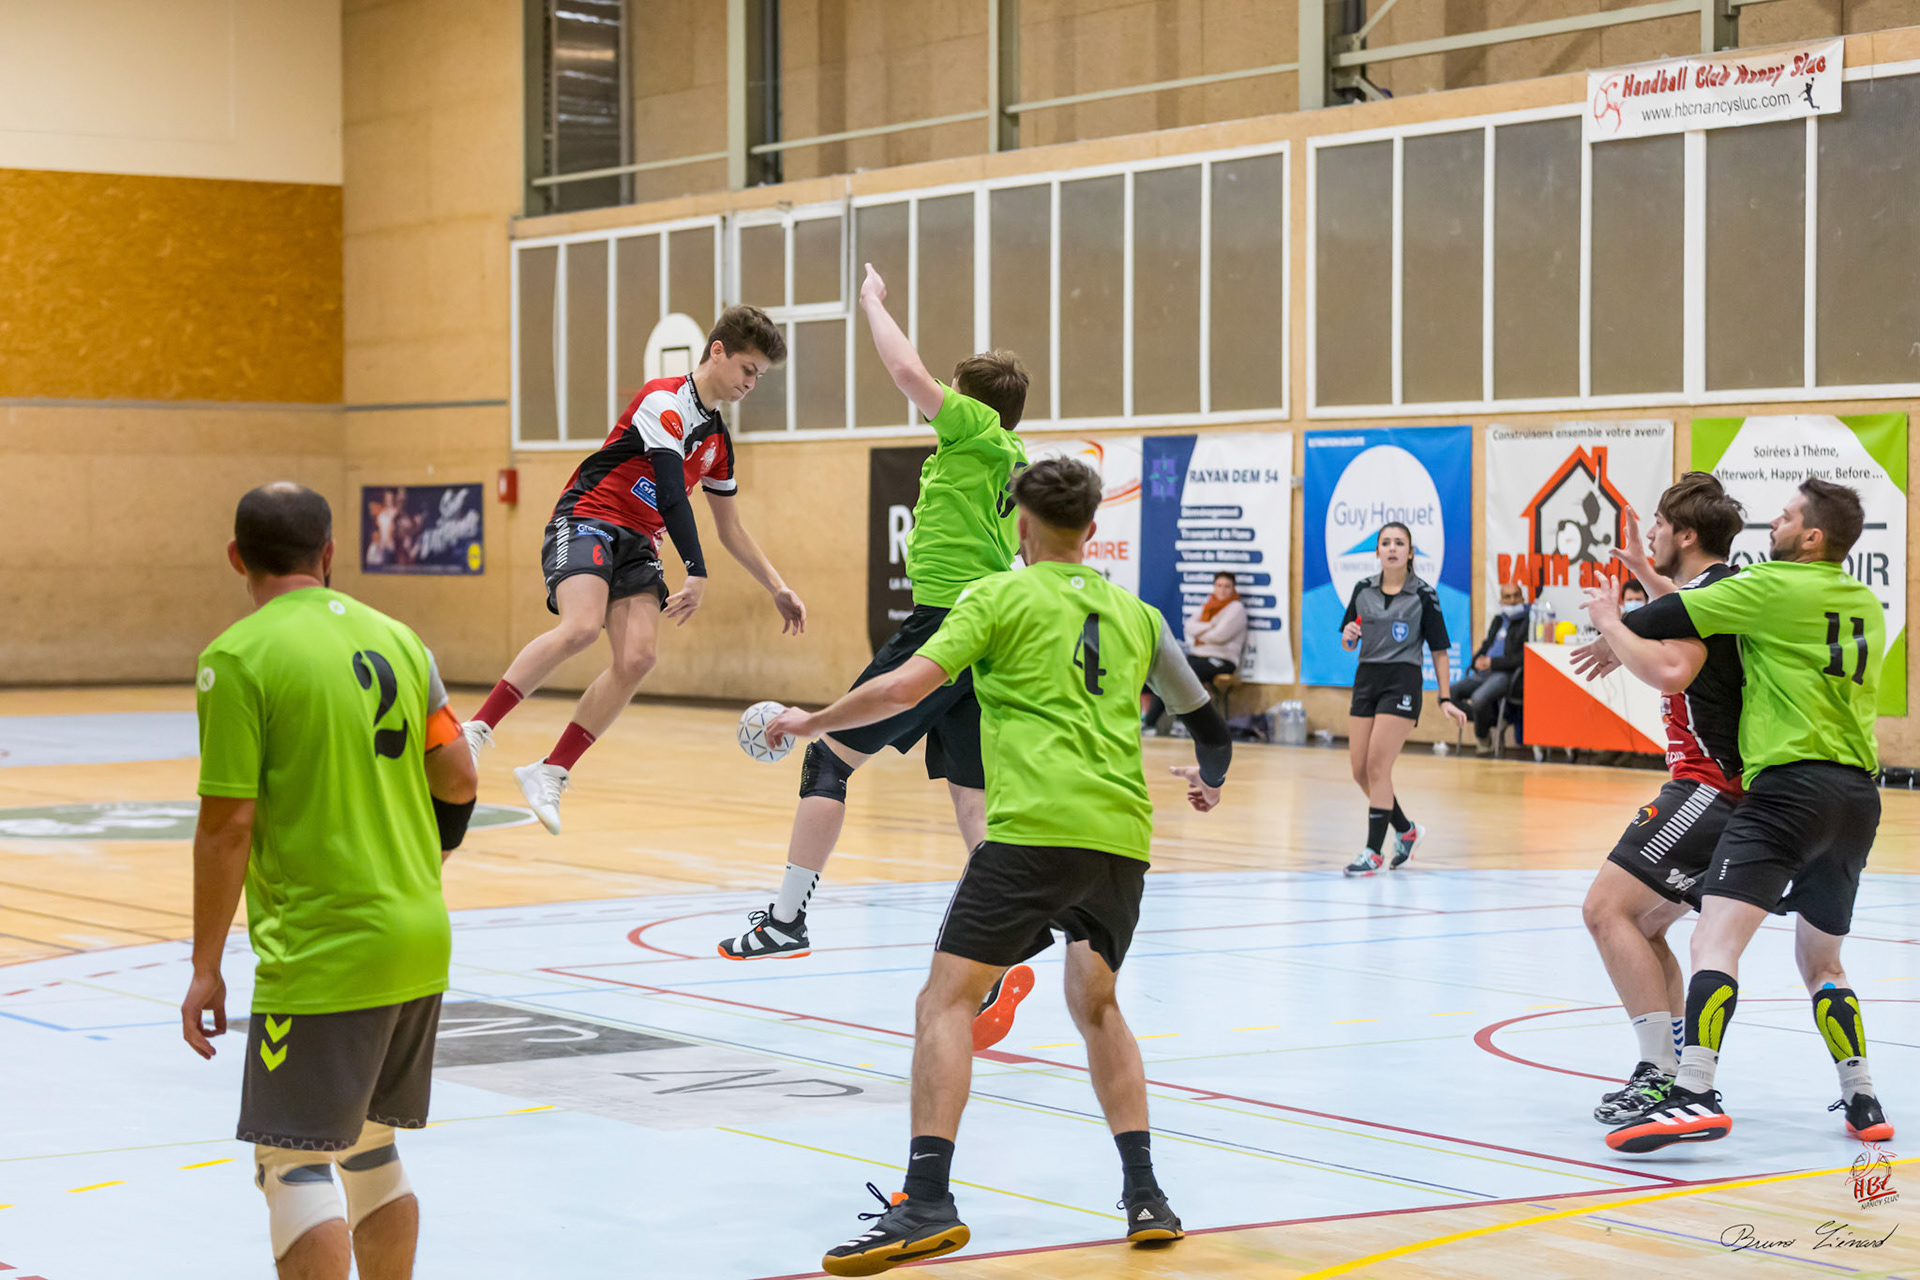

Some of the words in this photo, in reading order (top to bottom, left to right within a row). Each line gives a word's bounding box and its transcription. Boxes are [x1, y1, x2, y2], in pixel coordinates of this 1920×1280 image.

[1622, 66, 1687, 98] Handball
[1695, 64, 1731, 88] Club
[1734, 64, 1785, 87] Nancy
[1790, 52, 1826, 77] Sluc
[1641, 92, 1791, 121] www.hbcnancysluc.com
[1492, 429, 1554, 441] Construisons
[1555, 427, 1602, 439] ensemble
[1605, 427, 1631, 438] votre
[1634, 425, 1666, 437] avenir
[1753, 445, 1791, 458] Soirées
[1793, 445, 1800, 457] à
[1802, 444, 1839, 459] Thème,
[1189, 470, 1229, 483] RAYAN
[1232, 470, 1260, 483] DEM
[1265, 469, 1278, 483] 54
[1771, 468, 1802, 482] Happy
[1806, 467, 1833, 480] Hour,
[1334, 502, 1367, 531] Guy
[1073, 612, 1106, 696] 4
[1823, 612, 1868, 686] 11
[352, 650, 408, 760] 2
